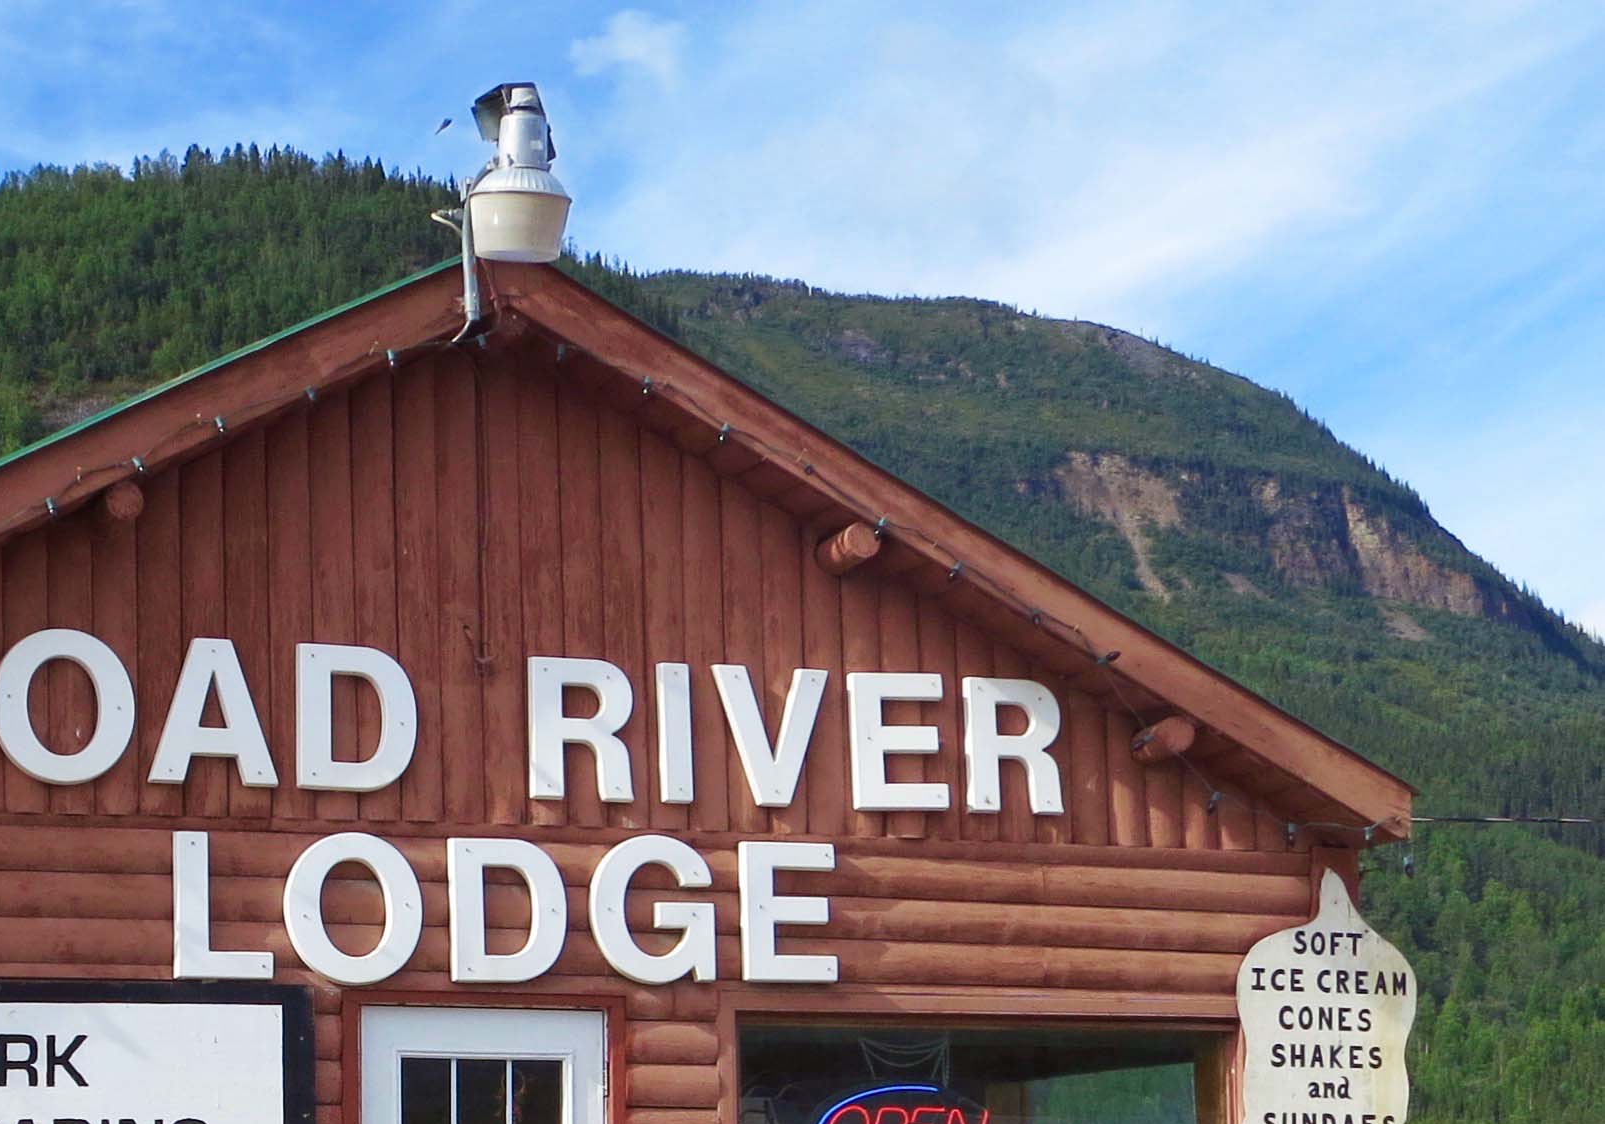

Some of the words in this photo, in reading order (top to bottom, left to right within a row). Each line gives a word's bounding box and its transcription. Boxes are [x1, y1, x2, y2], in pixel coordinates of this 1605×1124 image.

[527, 655, 1064, 815] RIVER
[172, 831, 839, 986] LODGE
[1293, 930, 1364, 957] SOFT
[1251, 967, 1304, 992] ICE
[1316, 968, 1407, 996] CREAM
[1278, 1005, 1372, 1032] CONES
[1270, 1043, 1383, 1070] SHAKES
[1307, 1075, 1353, 1100] and
